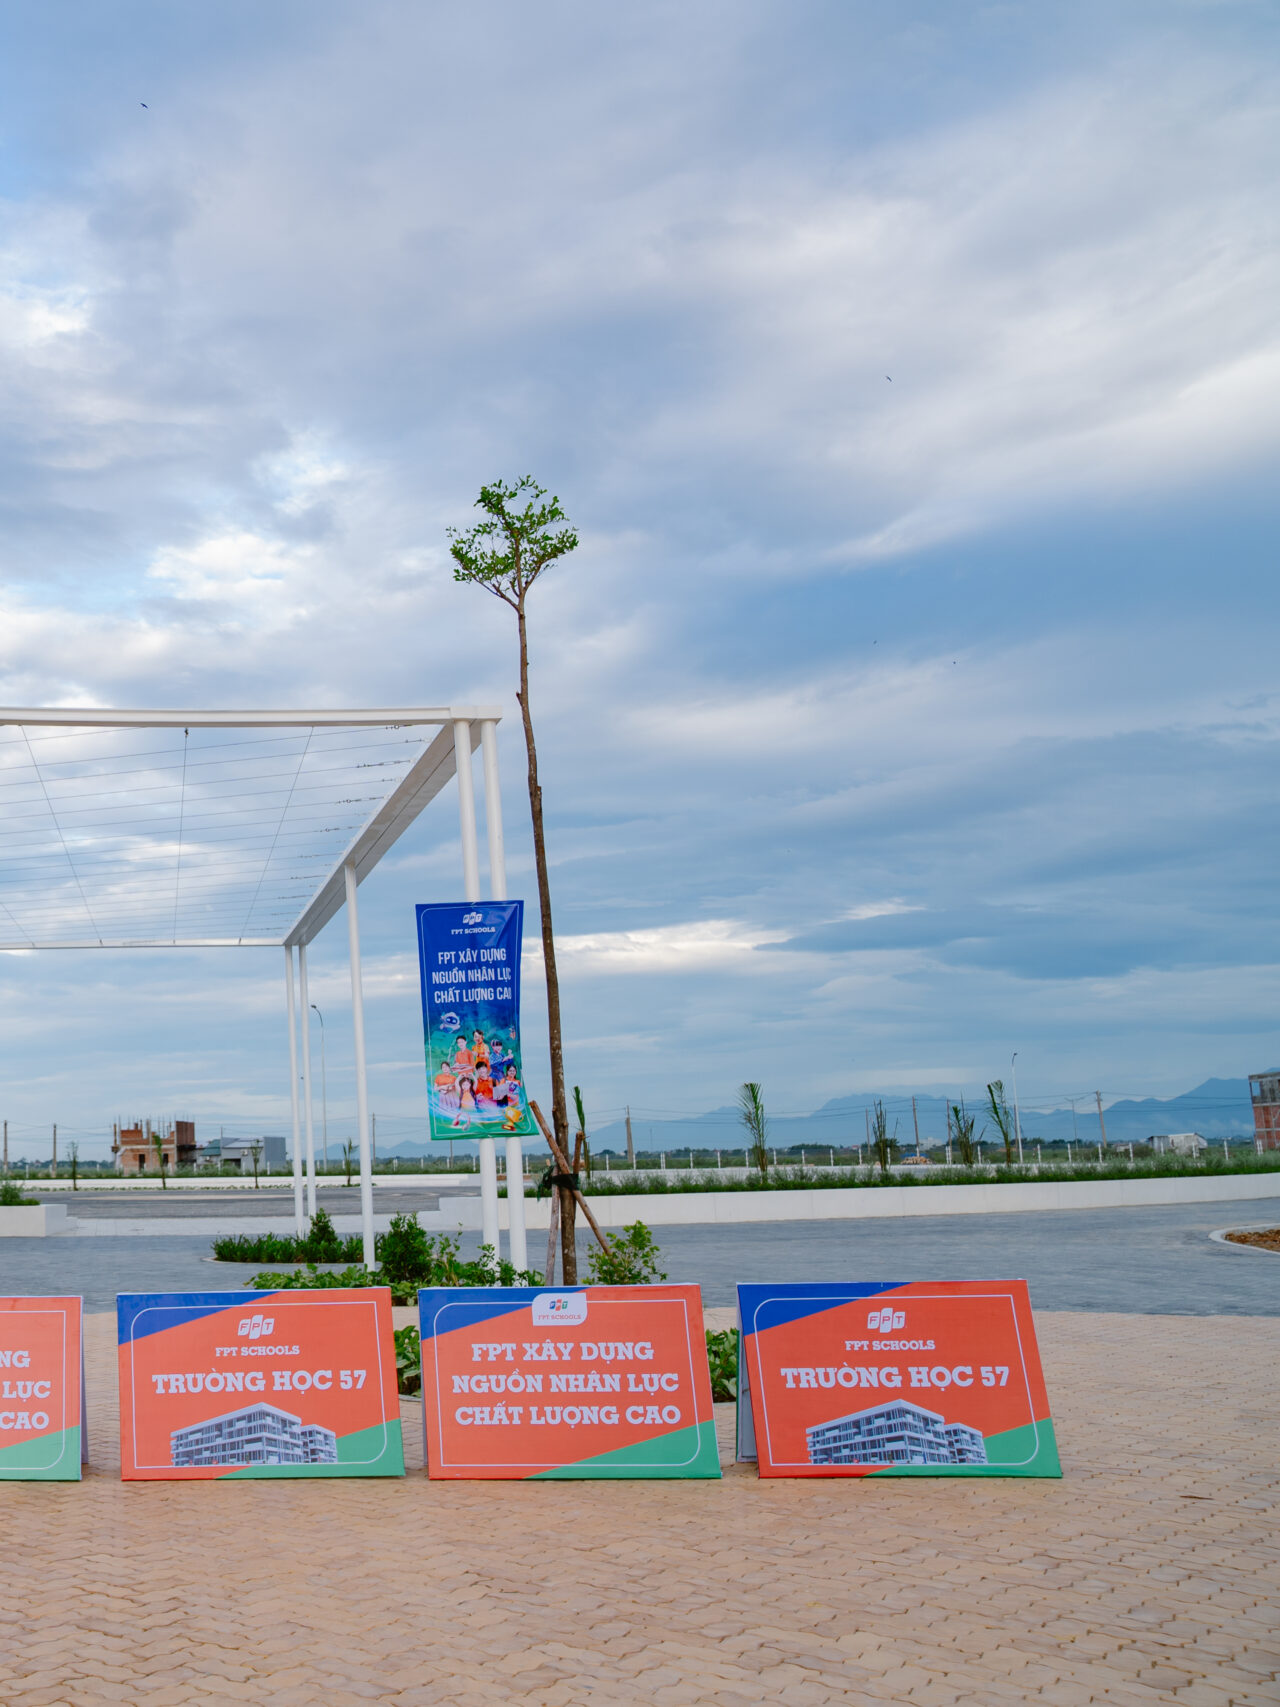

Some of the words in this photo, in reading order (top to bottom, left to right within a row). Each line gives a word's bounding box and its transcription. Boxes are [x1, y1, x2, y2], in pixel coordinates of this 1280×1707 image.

[438, 952, 456, 964] FPT
[459, 948, 478, 963] XÂY
[480, 948, 506, 964] DỰNG
[432, 967, 465, 984] NGUỒN
[468, 966, 495, 982] NHÂN
[434, 986, 460, 1003] CHẤT
[463, 988, 494, 1003] LƯỢNG
[215, 1347, 238, 1357] FPT
[241, 1346, 299, 1356] SCHOOLS
[472, 1343, 516, 1361] FPT
[522, 1340, 574, 1360] XÂY
[845, 1341, 869, 1350] FPT
[872, 1340, 935, 1350] SCHOOLS
[152, 1368, 266, 1393] TRƯỜNG
[272, 1370, 332, 1394] HỌC
[340, 1370, 366, 1389] 57
[452, 1368, 542, 1393] NGUỒN
[550, 1370, 621, 1392] NHÂN
[627, 1373, 679, 1396] LỰC
[780, 1362, 902, 1388] TRƯỜNG
[909, 1366, 974, 1391] HỌC
[981, 1366, 1010, 1387] 57
[2, 1381, 51, 1402] LỰC
[455, 1401, 524, 1425] CHẤT
[530, 1406, 620, 1428] LƯỢNG
[626, 1406, 681, 1424] CAO
